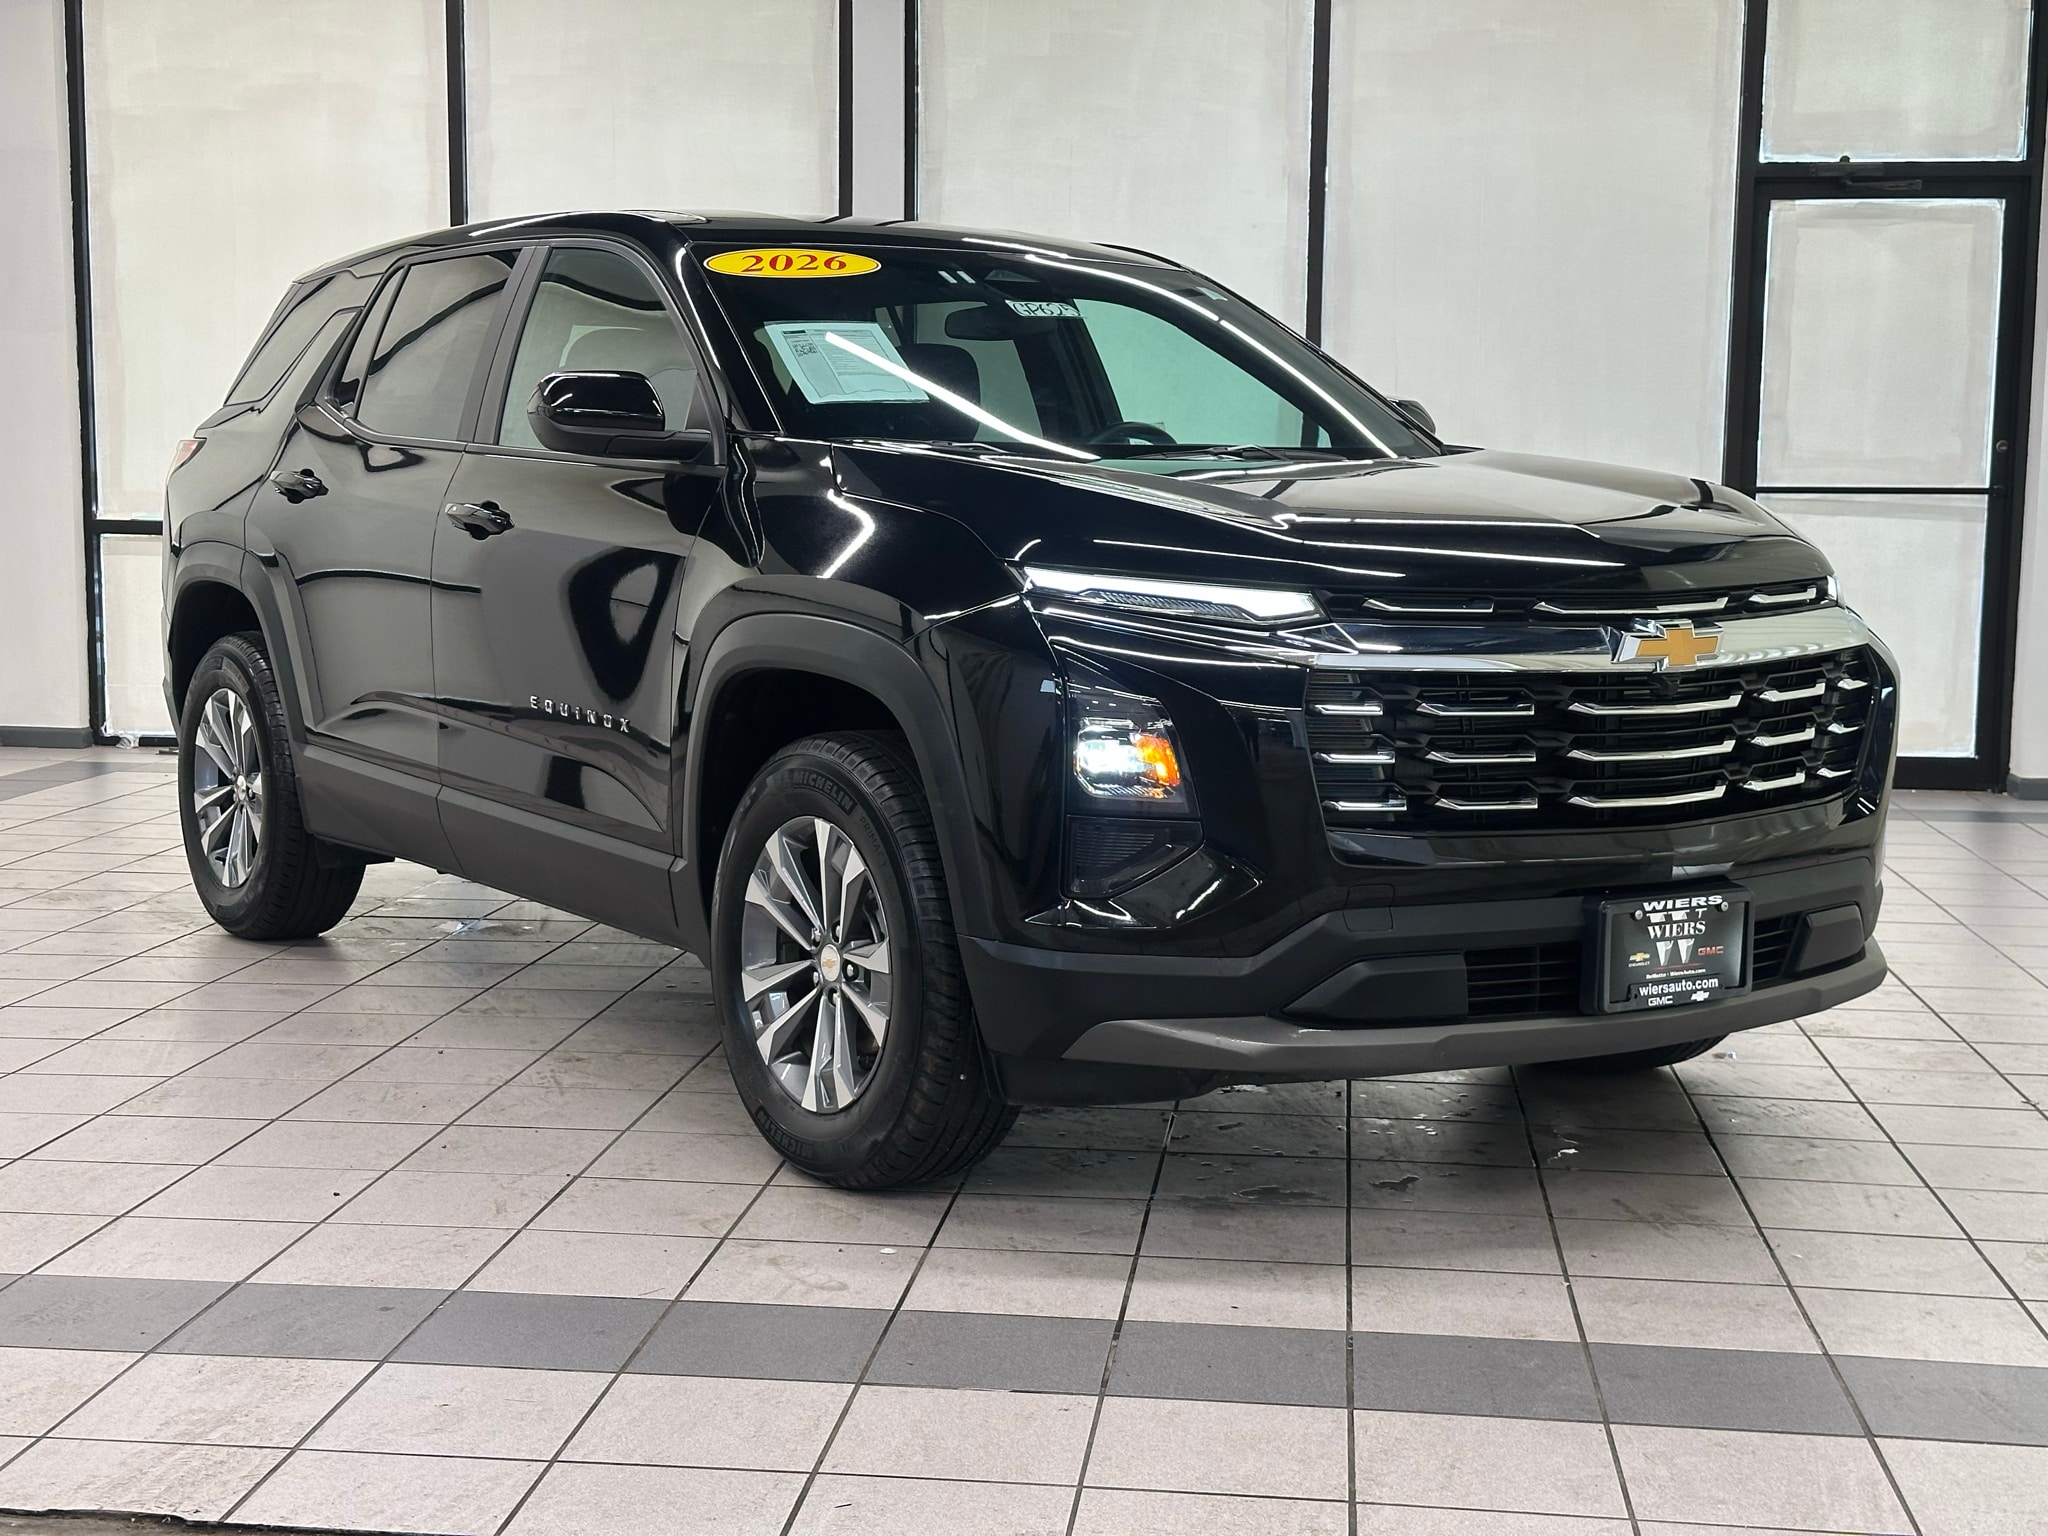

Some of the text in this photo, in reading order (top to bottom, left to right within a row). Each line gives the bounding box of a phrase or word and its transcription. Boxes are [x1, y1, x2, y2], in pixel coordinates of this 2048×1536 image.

[741, 254, 847, 272] 2026
[530, 695, 629, 733] EQUINOX
[793, 770, 854, 811] MICHELIN
[1643, 895, 1723, 911] WIERS
[1647, 921, 1706, 939] WIERS
[1698, 946, 1724, 956] GMC
[1639, 978, 1719, 996] wiersauto.com
[1648, 995, 1673, 1007] GMC
